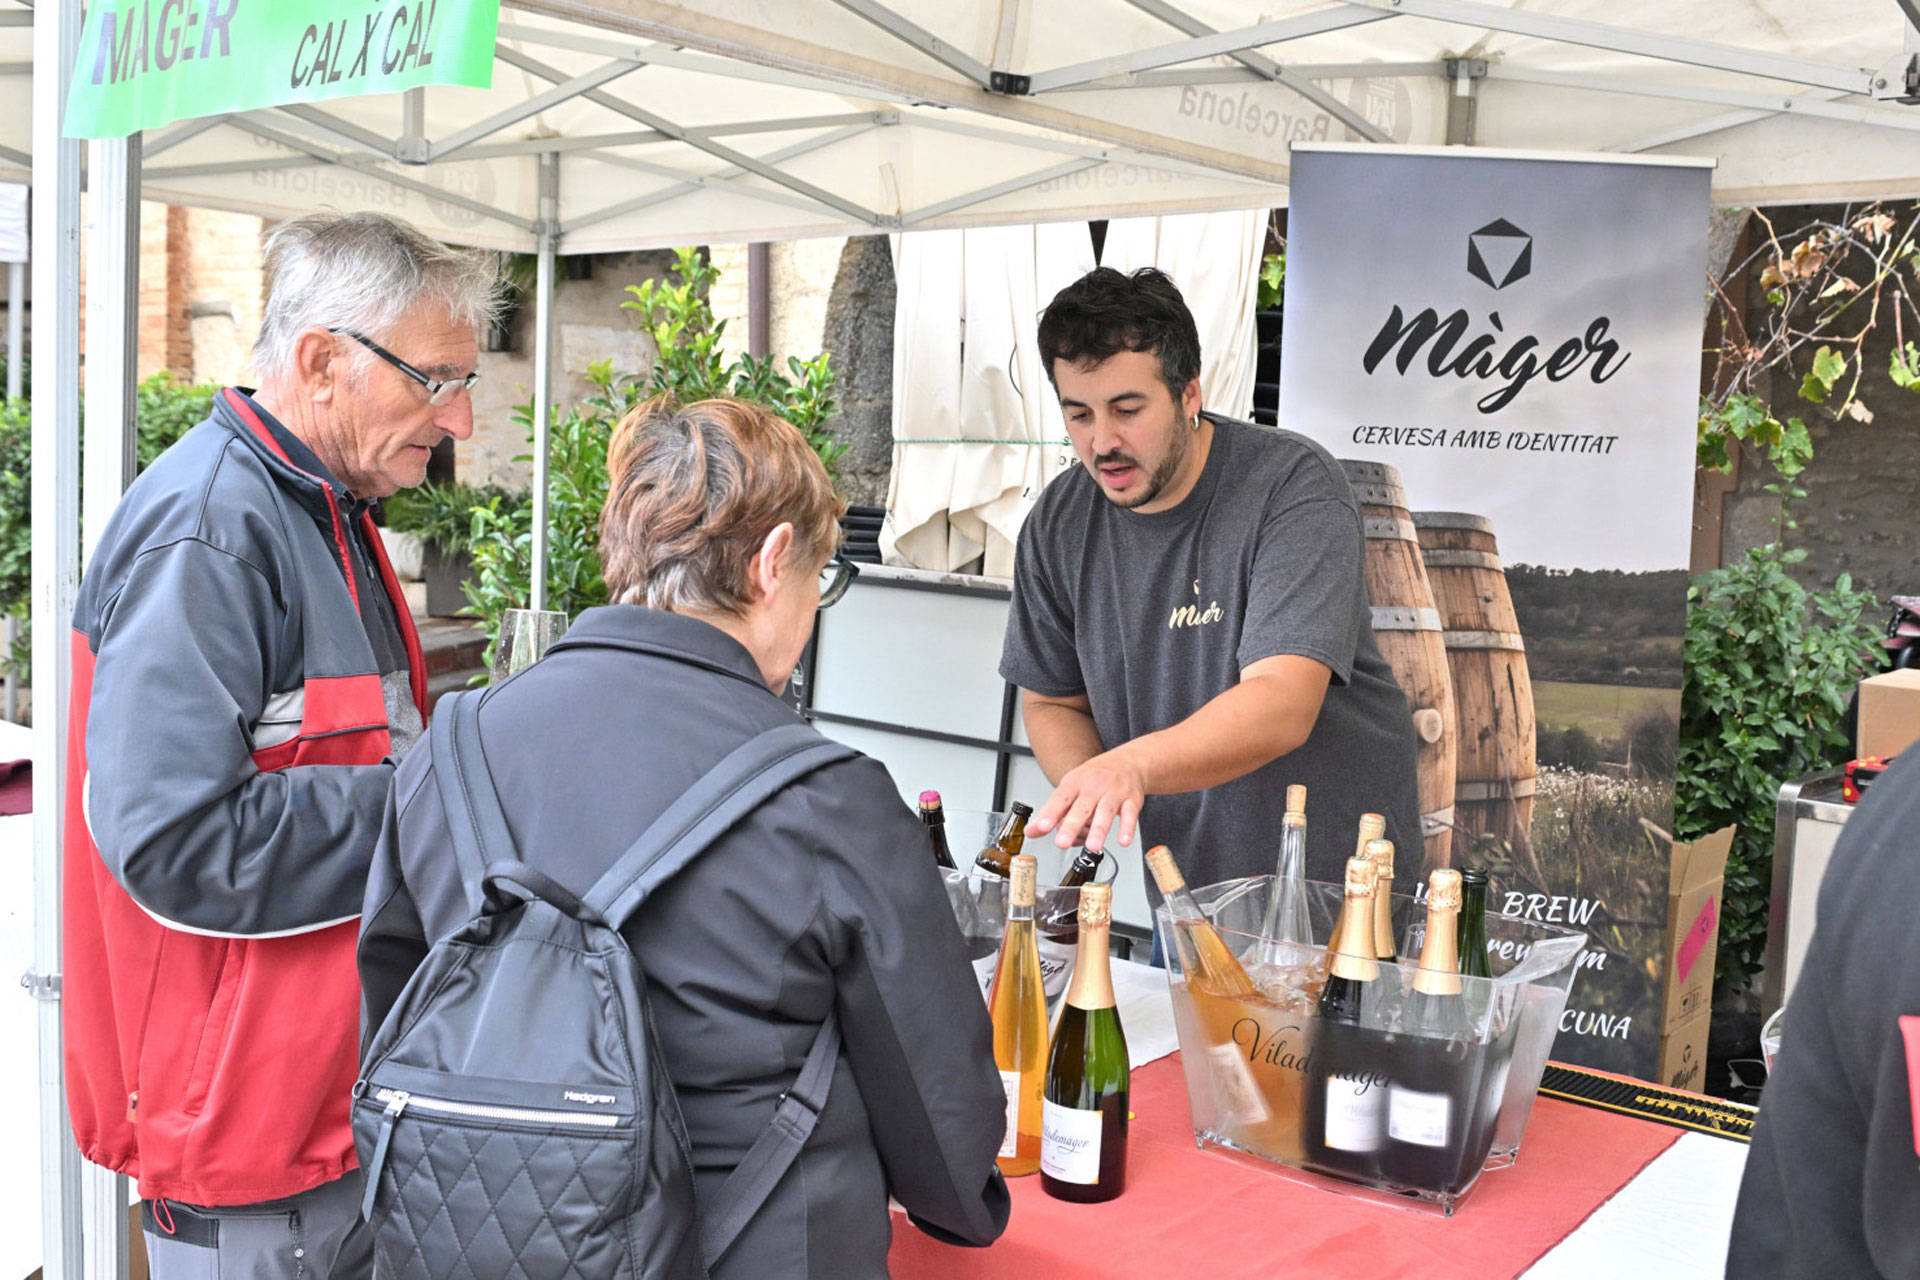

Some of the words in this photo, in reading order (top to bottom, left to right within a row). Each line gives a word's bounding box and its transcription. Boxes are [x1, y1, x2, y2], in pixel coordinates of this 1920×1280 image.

[291, 20, 347, 89] CAL
[348, 11, 383, 78] X
[381, 0, 436, 75] CAL
[1363, 304, 1631, 414] Màger
[1352, 425, 1446, 447] CERVESA
[1450, 429, 1502, 450] AMB
[1506, 431, 1619, 454] IDENTITAT
[1502, 892, 1600, 925] BREW
[1558, 1009, 1632, 1040] CUNA
